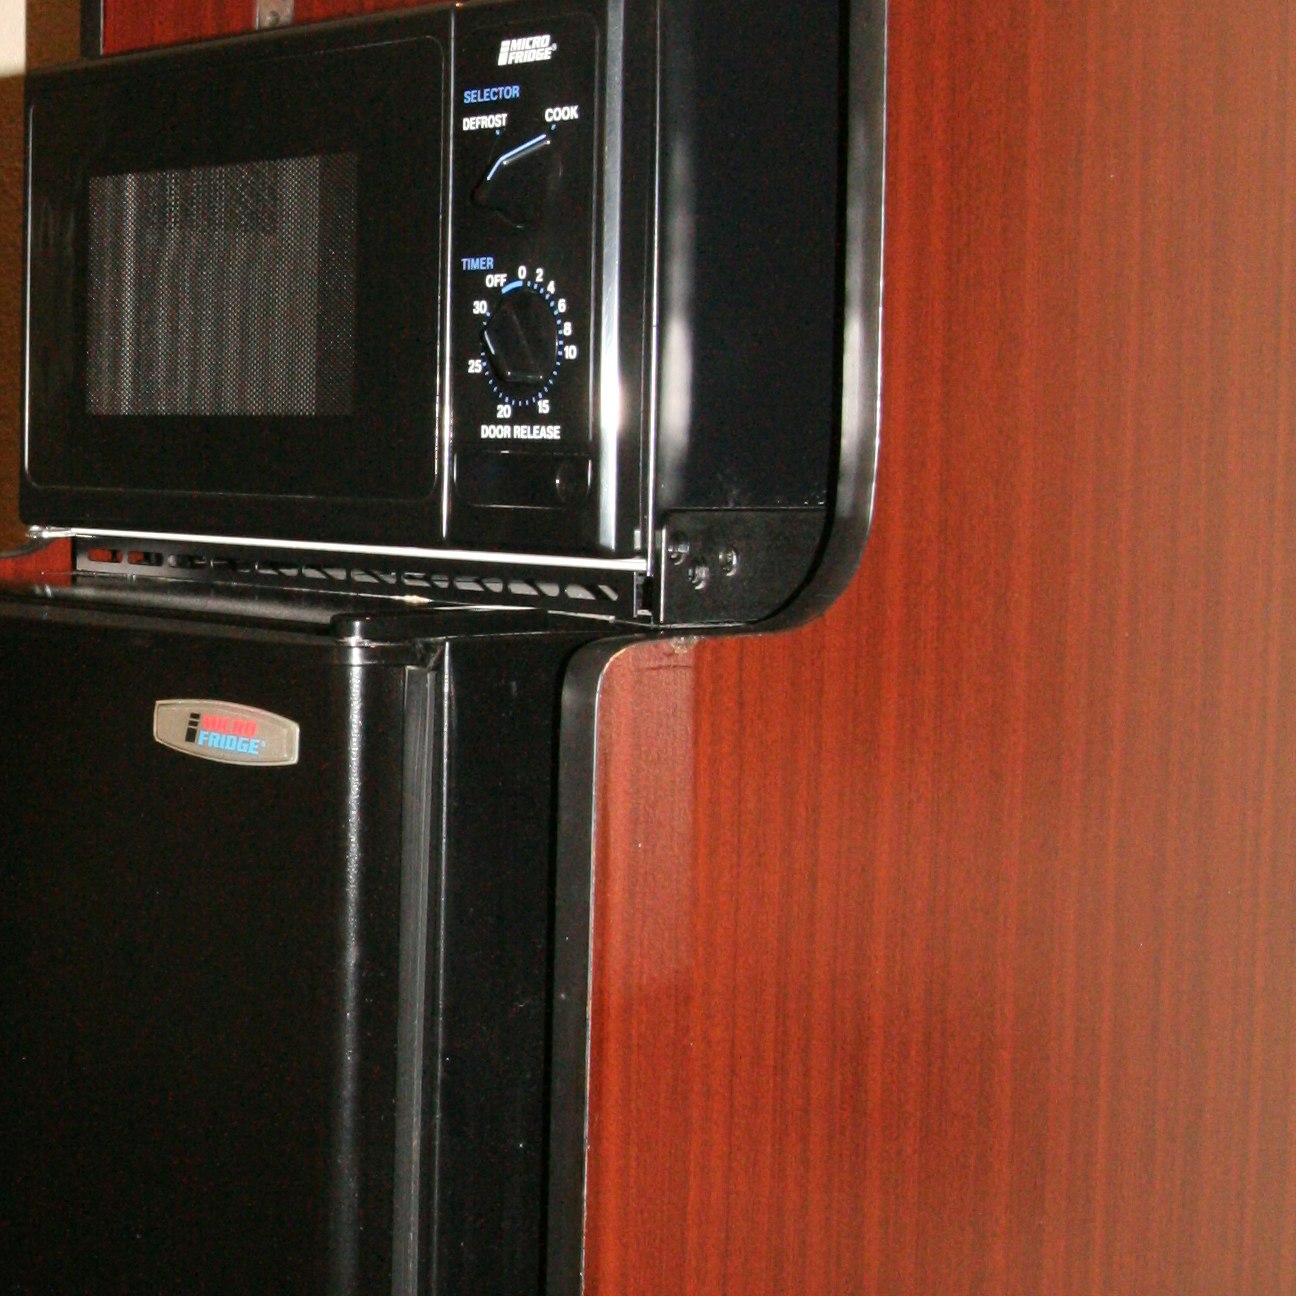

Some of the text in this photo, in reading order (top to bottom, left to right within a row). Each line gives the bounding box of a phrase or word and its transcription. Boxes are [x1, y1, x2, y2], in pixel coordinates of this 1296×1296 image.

[509, 34, 551, 51] MICRO
[463, 85, 520, 104] SELECTOR
[544, 105, 579, 123] COOK
[462, 113, 508, 131] DEFROST
[461, 257, 494, 271] TIMER
[517, 266, 527, 280] 0
[535, 268, 544, 283] 2
[485, 273, 507, 289] OFF
[547, 280, 556, 295] 4
[472, 299, 488, 315] 30
[557, 298, 567, 314] 6
[563, 322, 572, 337] 8
[563, 345, 578, 360] 10
[467, 359, 483, 374] 25
[496, 404, 512, 419] 20
[537, 400, 550, 414] 15
[480, 425, 561, 440] DOOR RELEASE
